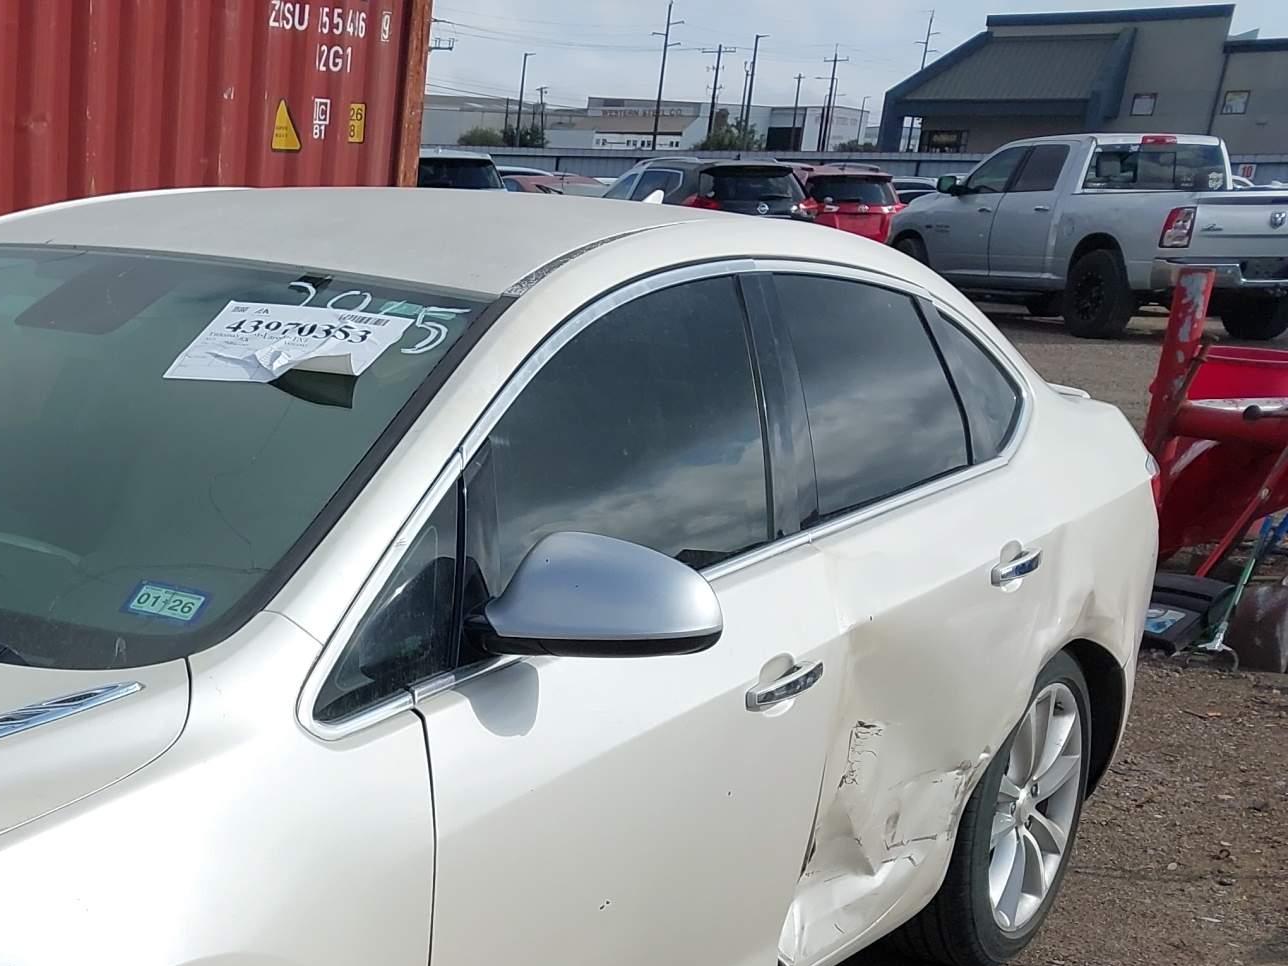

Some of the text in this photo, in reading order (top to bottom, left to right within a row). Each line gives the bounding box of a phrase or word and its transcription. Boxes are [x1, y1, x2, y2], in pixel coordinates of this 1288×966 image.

[312, 124, 326, 140] 81
[1240, 165, 1254, 178] 10
[225, 318, 372, 345] 43970353
[136, 592, 196, 615] 01 26
